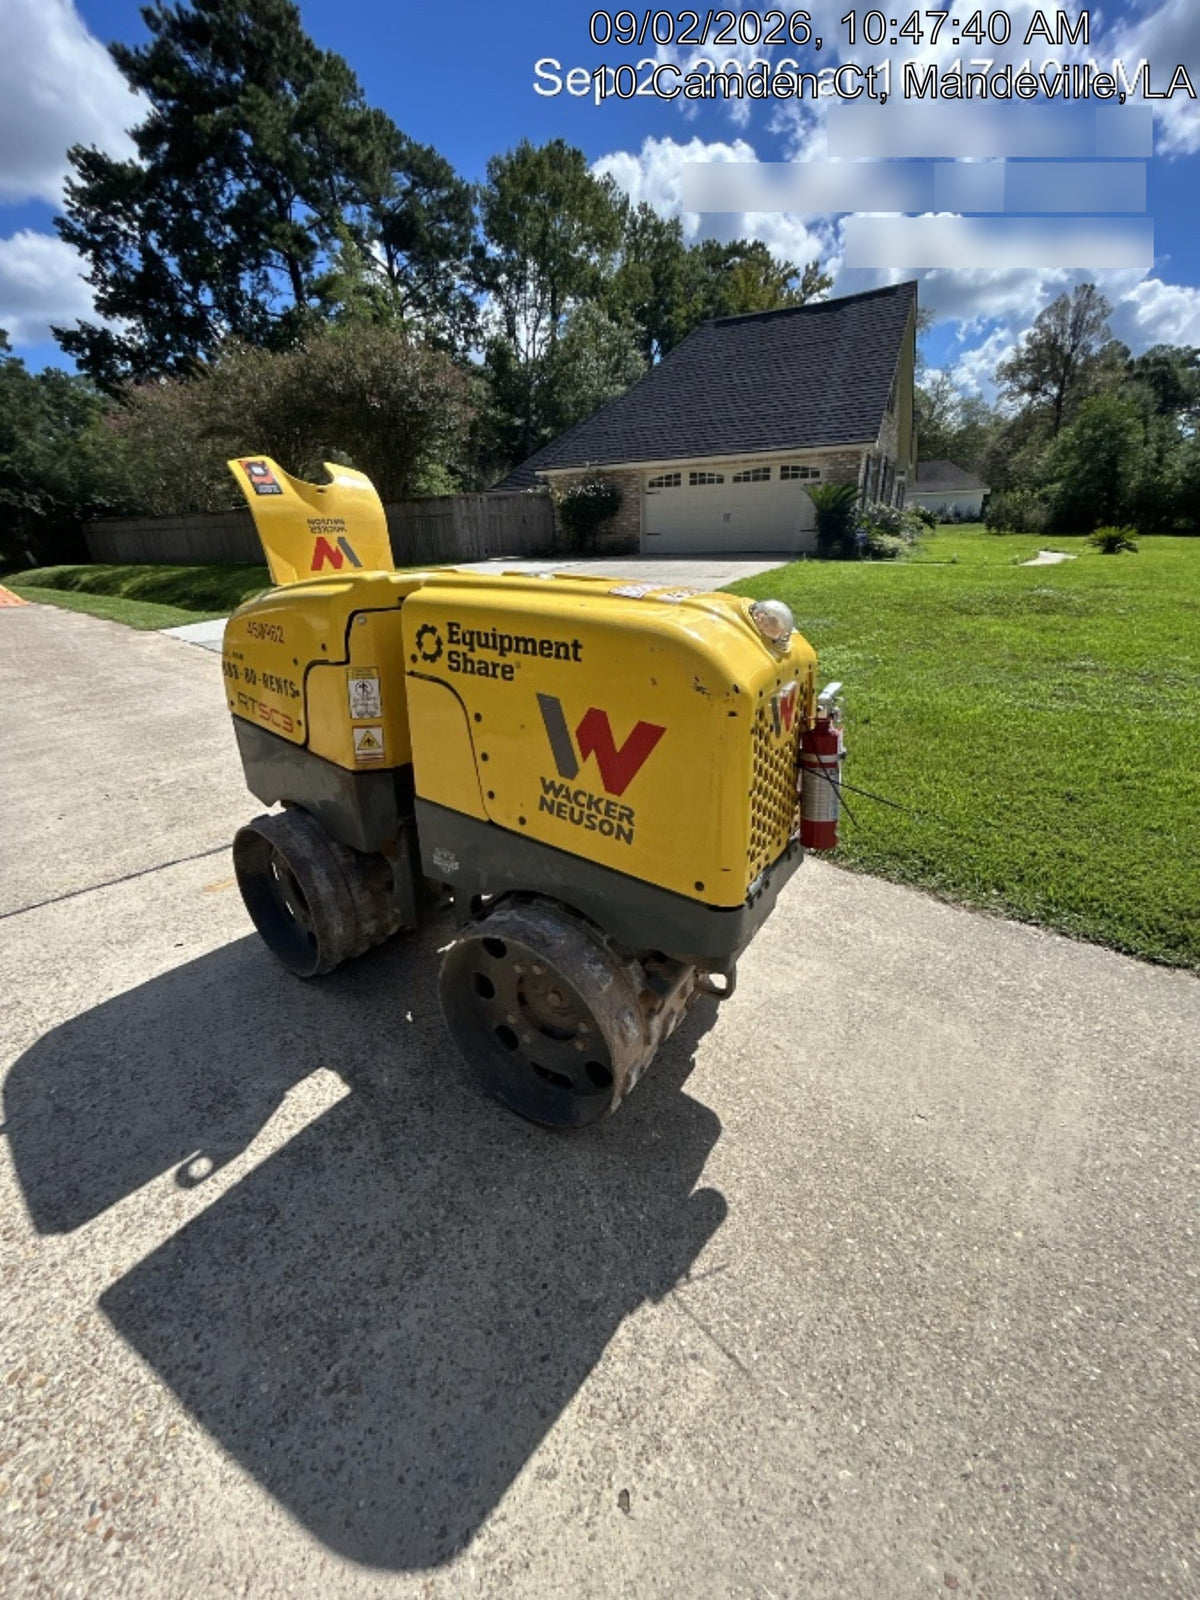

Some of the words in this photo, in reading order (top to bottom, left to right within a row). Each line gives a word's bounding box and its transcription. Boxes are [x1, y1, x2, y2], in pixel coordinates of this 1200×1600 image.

[447, 622, 584, 663] Equipment
[447, 651, 515, 682] Share
[538, 795, 635, 846] NEUSON
[539, 776, 636, 827] WACKER
